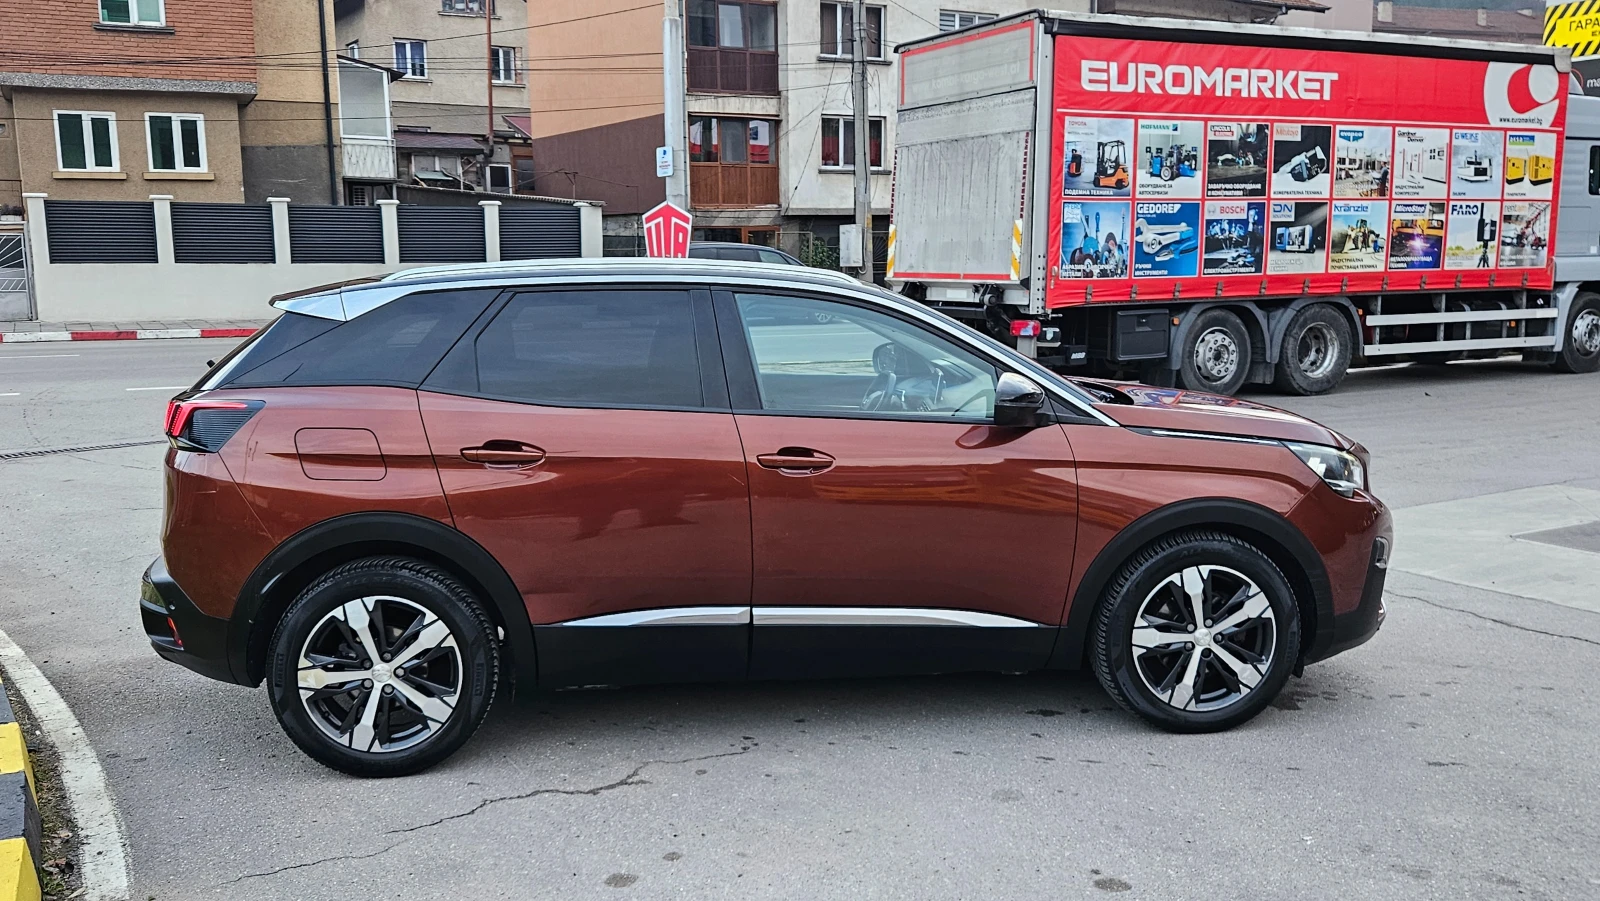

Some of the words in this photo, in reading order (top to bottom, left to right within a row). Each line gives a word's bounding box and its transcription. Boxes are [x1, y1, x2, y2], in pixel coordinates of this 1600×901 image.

[1080, 59, 1339, 101] EUROMARKET
[1499, 116, 1543, 125] www.euromarket.bg
[1137, 203, 1175, 213] GEDORE
[1219, 206, 1245, 214] BOSCH
[1272, 203, 1293, 213] DN
[1394, 204, 1425, 213] MicroStep
[1451, 204, 1479, 215] FARO
